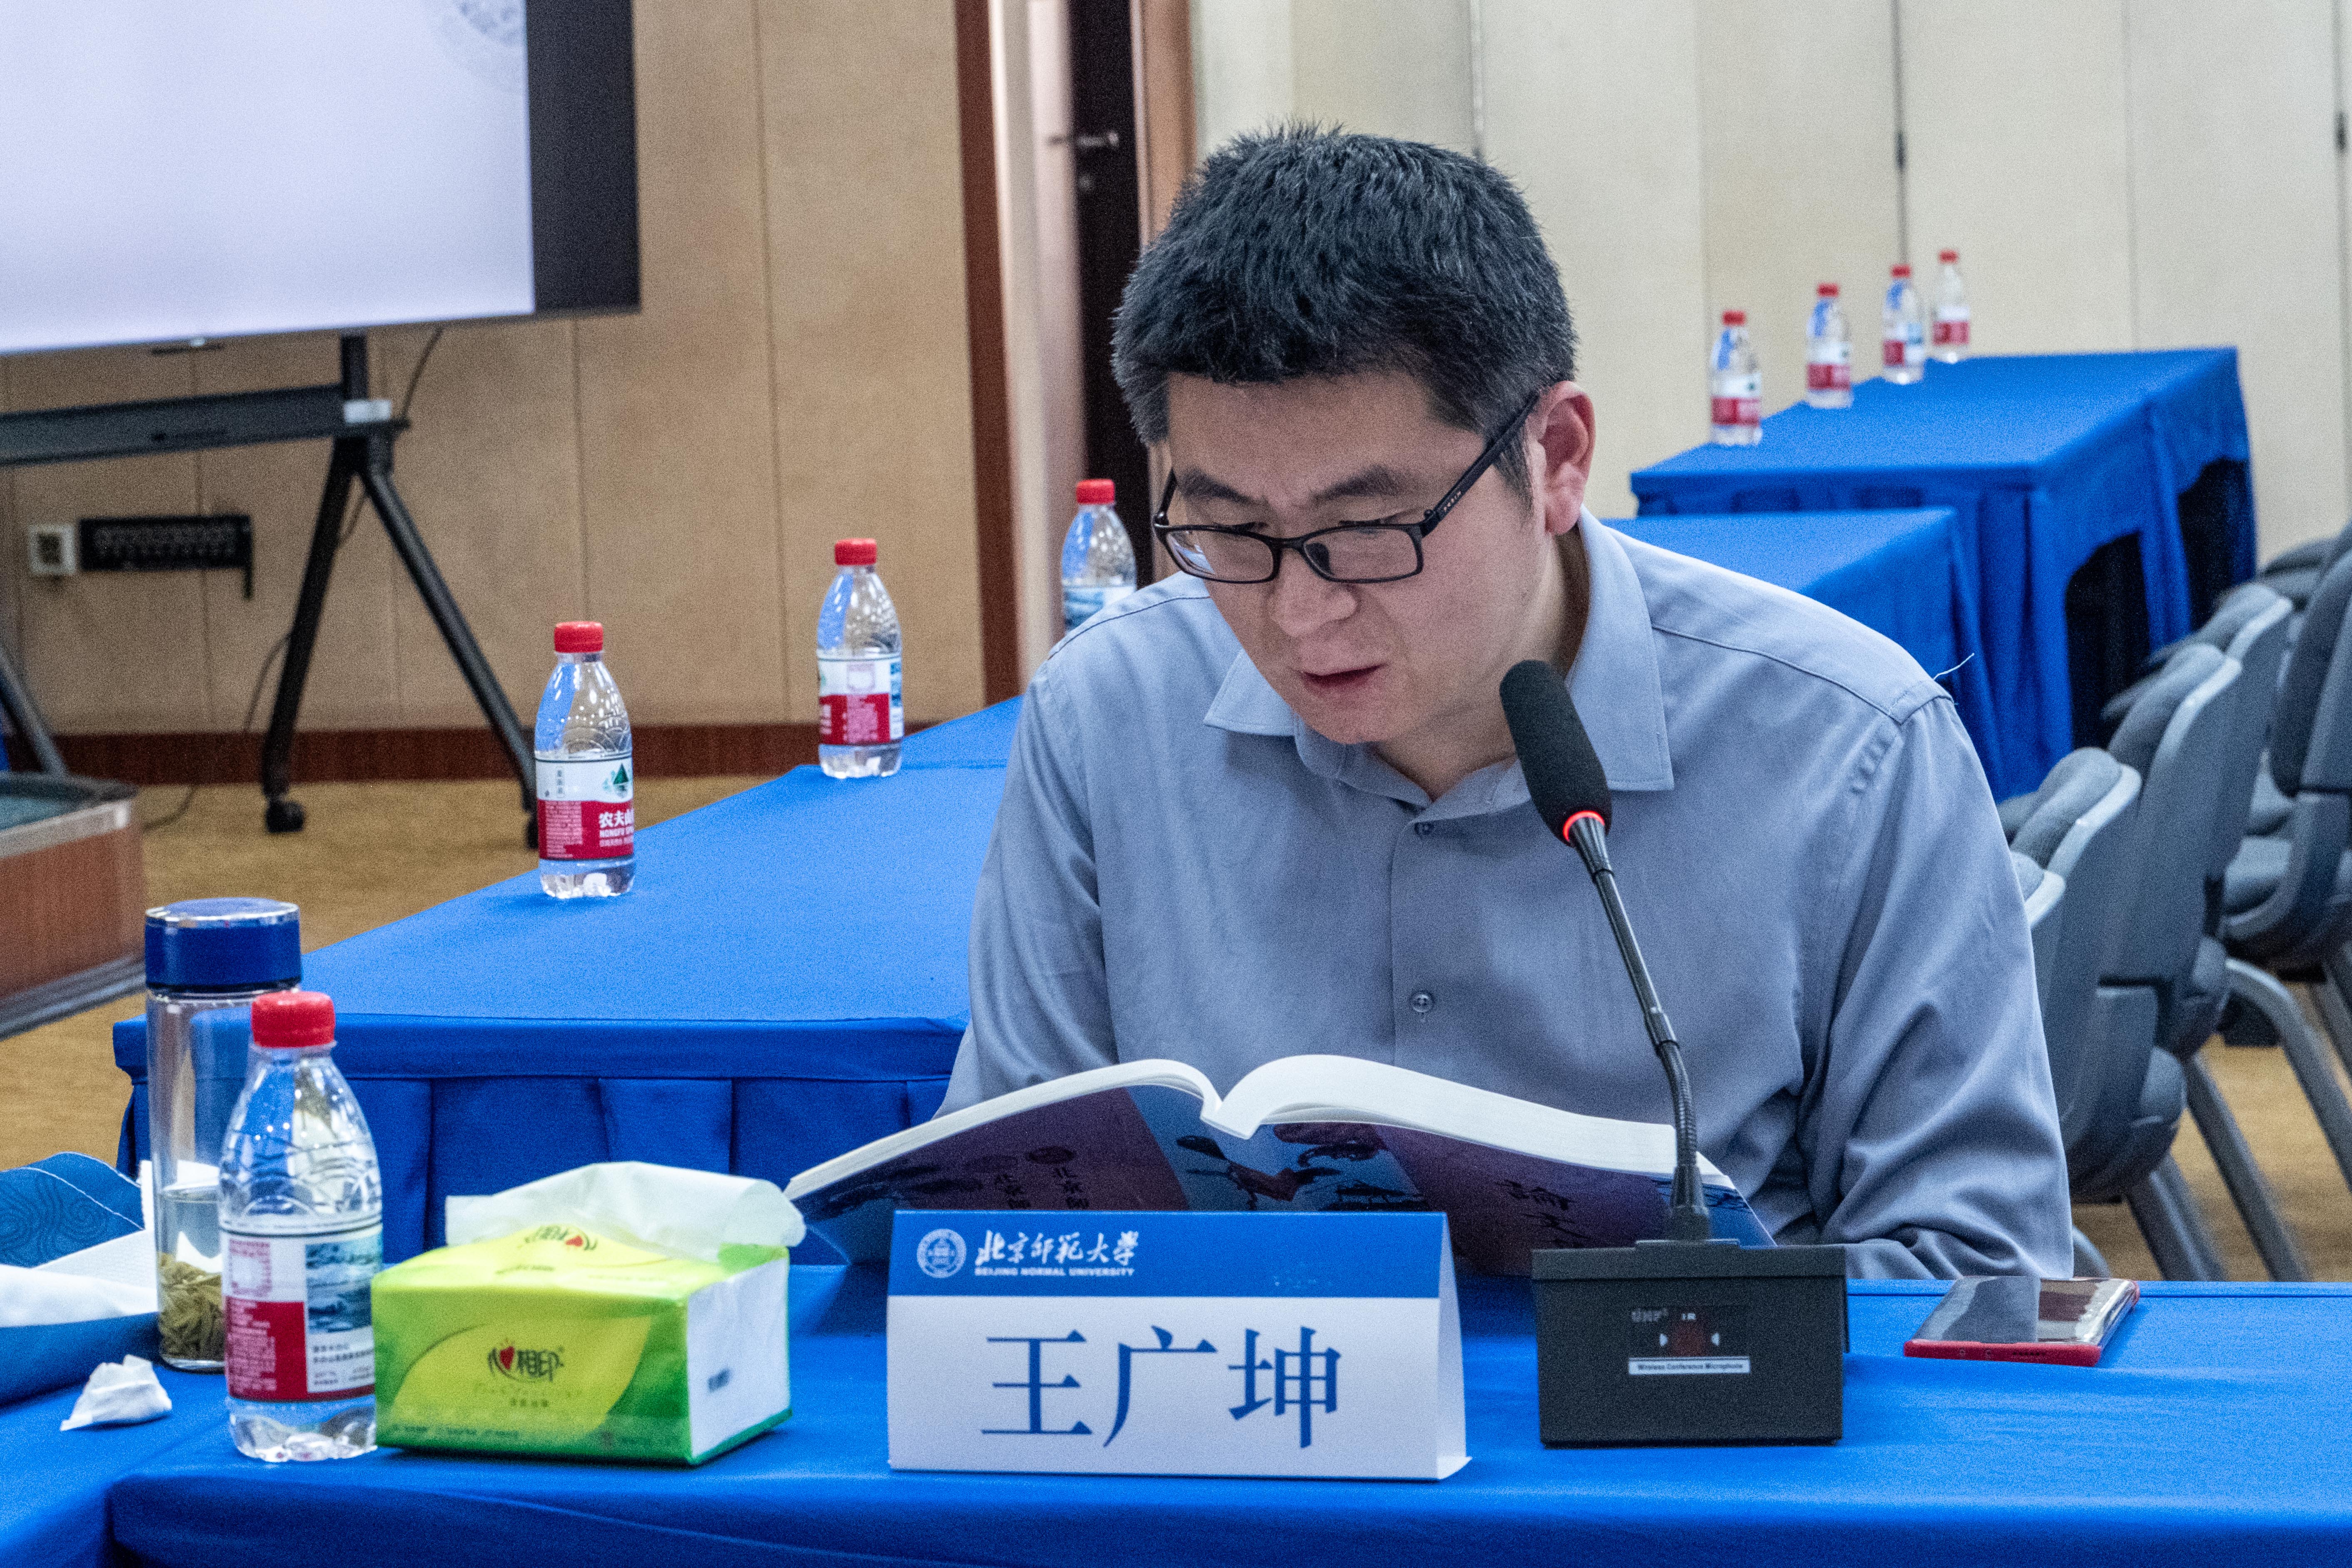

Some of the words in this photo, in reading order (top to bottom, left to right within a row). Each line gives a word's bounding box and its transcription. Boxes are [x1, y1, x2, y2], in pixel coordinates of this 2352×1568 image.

[975, 1267, 1018, 1276] BEIJING
[1020, 1267, 1066, 1276] NORMAL
[1069, 1267, 1135, 1276] UNIVERSITY
[980, 1325, 1342, 1448] 王广坤
